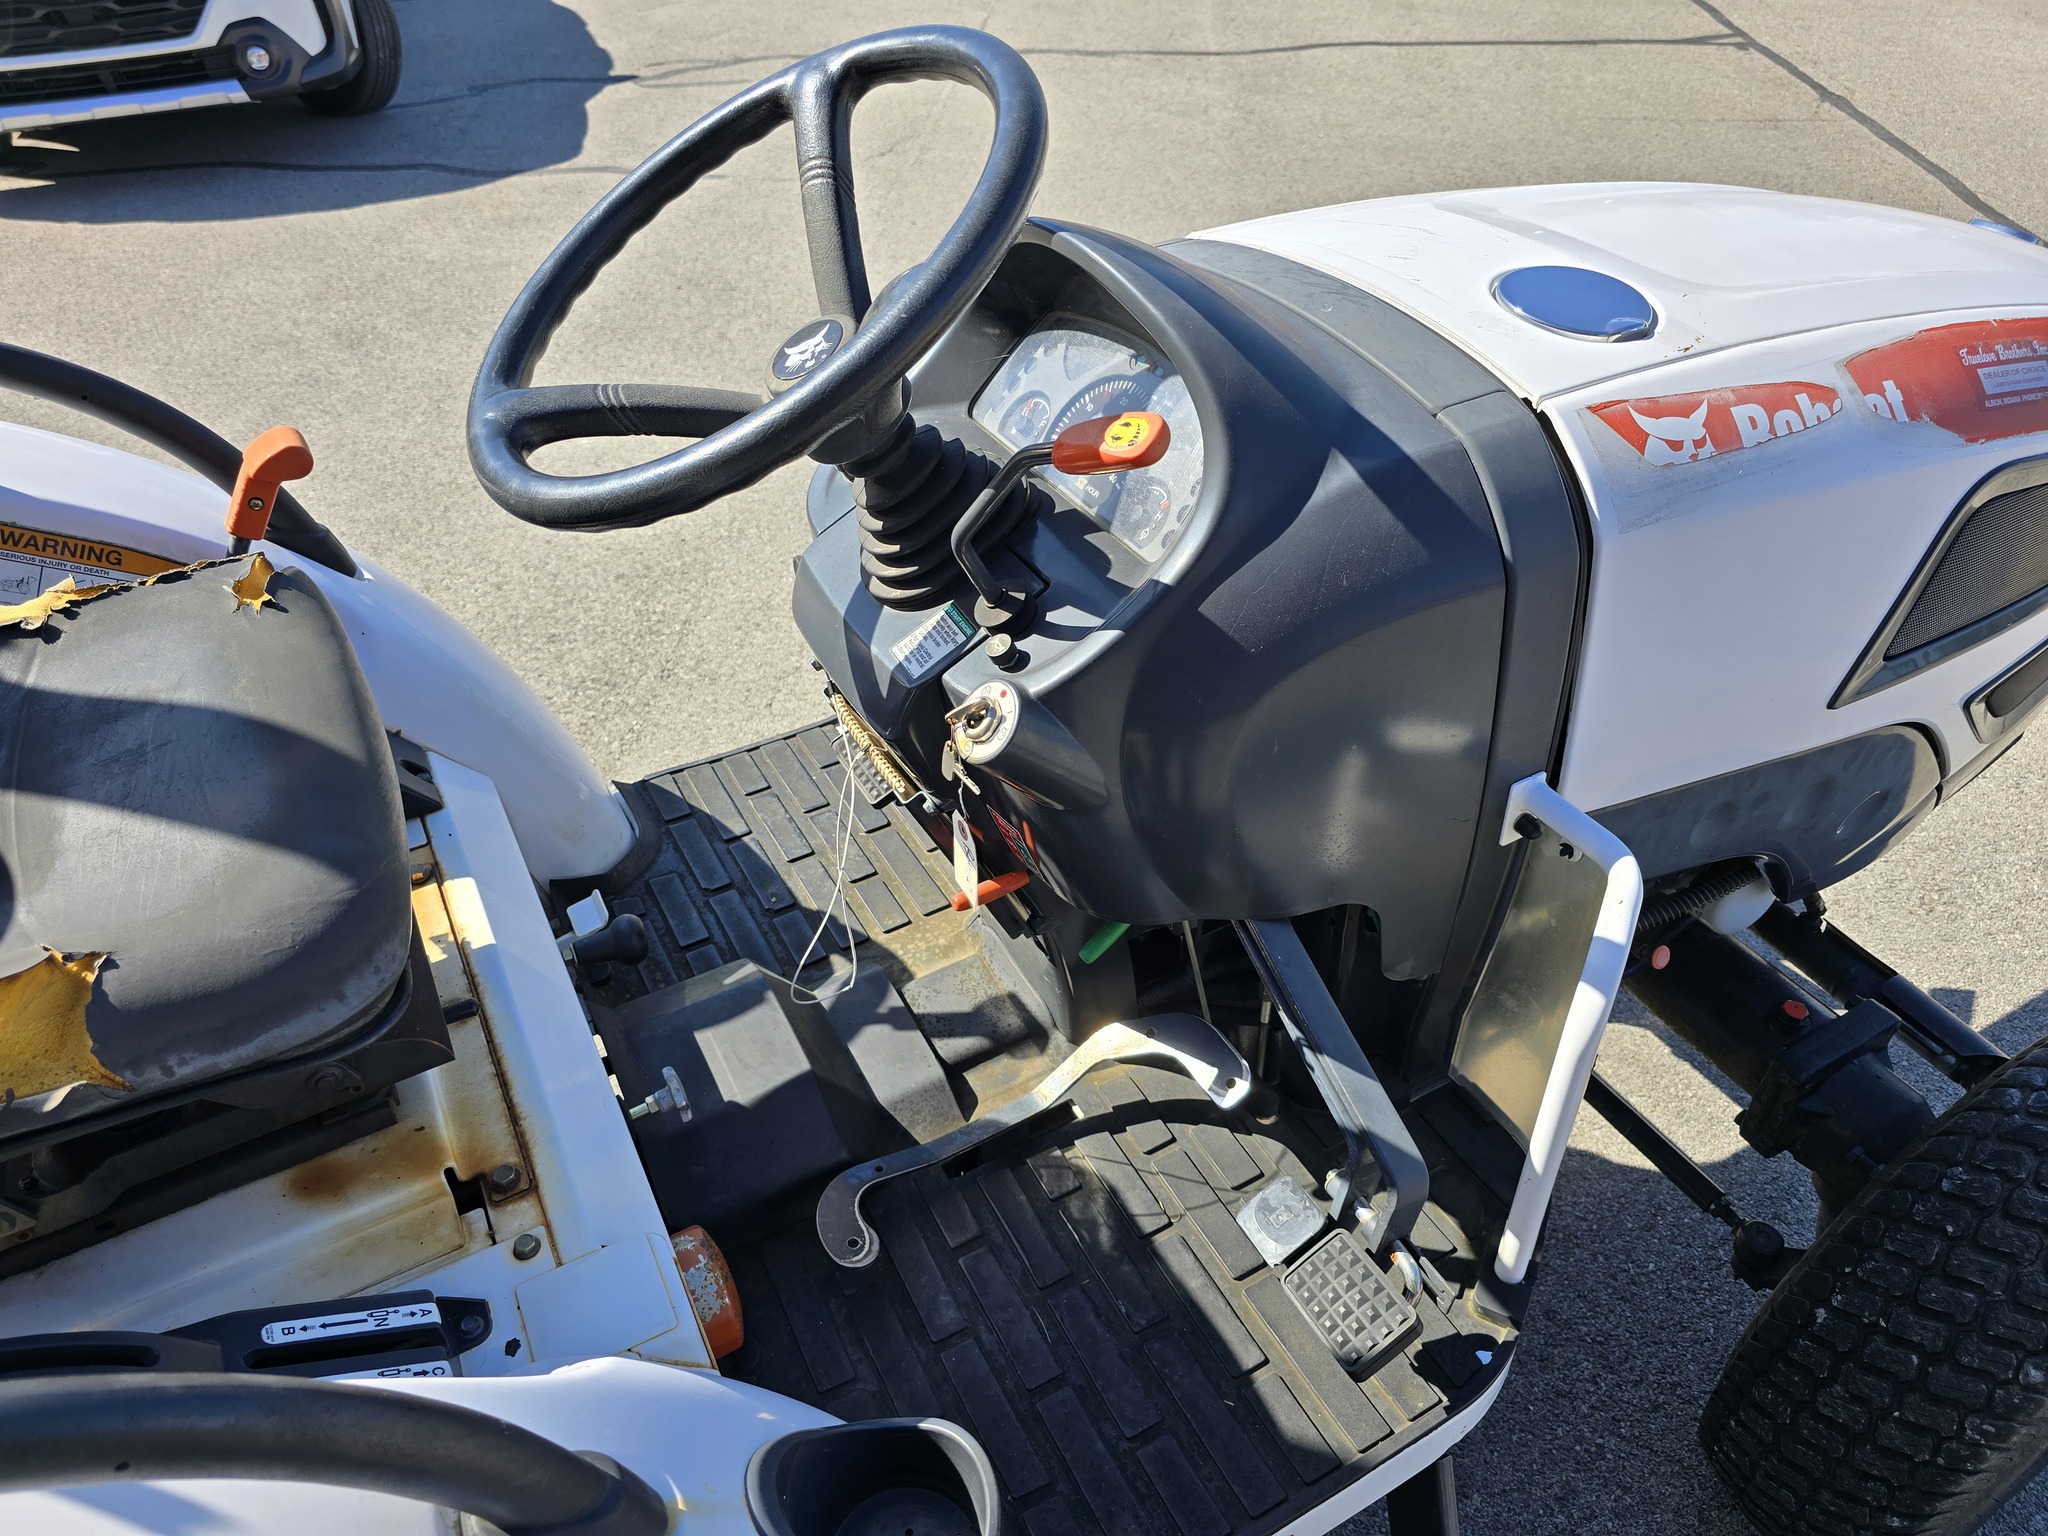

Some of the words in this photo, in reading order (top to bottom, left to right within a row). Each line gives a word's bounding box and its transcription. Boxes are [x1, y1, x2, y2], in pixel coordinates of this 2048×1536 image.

[1959, 347, 1997, 366] Truelove
[1982, 369, 2011, 380] DEALER
[2021, 365, 2047, 375] CHOICE
[1119, 396, 1129, 407] 20
[1108, 473, 1118, 484] 40
[1085, 484, 1100, 499] HOUR
[0, 529, 124, 567] WARNING
[0, 552, 37, 564] SERIOUS
[38, 558, 69, 570] INJURY
[69, 563, 82, 573] OR
[83, 567, 110, 577] DEATH
[950, 610, 962, 622] START
[958, 620, 973, 636] ENGINE
[419, 1308, 432, 1318] A
[373, 1317, 389, 1327] N
[281, 1326, 295, 1336] B
[432, 1366, 445, 1376] C
